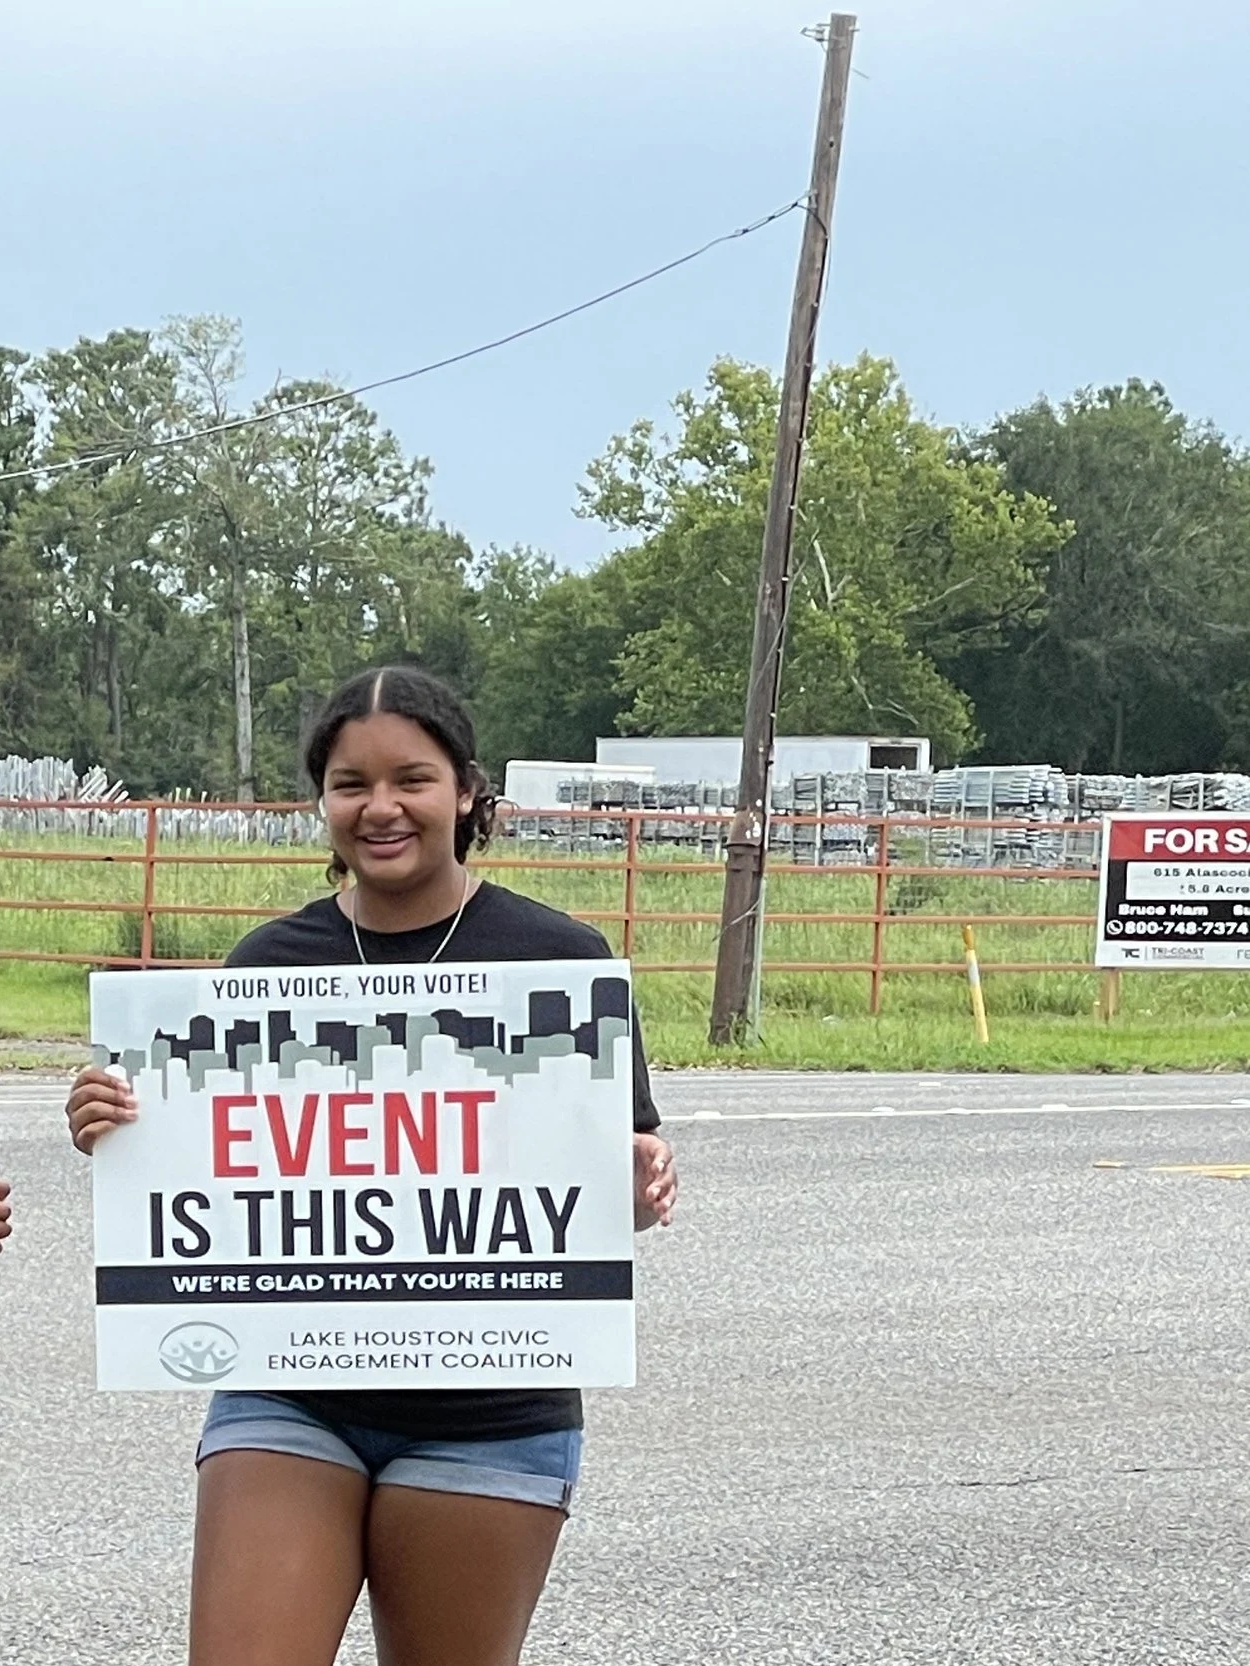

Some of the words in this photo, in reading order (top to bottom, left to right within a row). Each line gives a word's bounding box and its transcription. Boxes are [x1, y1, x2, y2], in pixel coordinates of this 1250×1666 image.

[1144, 828, 1219, 854] FOR
[1118, 903, 1166, 916] Bruce
[1170, 904, 1209, 916] Ham
[1124, 921, 1249, 935] 800-748-7374
[212, 978, 269, 999] YOUR
[277, 976, 349, 998] VOICE,
[358, 975, 416, 996] YOUR
[423, 973, 487, 994] VOTE!
[212, 1089, 497, 1179] EVENT
[149, 1190, 211, 1259] IS
[233, 1188, 395, 1257] THIS
[417, 1186, 582, 1255] WAY
[172, 1275, 251, 1293] WE'RE
[255, 1274, 325, 1292] GLAD
[328, 1273, 398, 1291] THAT
[401, 1272, 495, 1290] YOU'RE
[500, 1272, 563, 1289] HERE
[290, 1331, 345, 1347] LAKE
[354, 1330, 473, 1346] HOUSTON
[481, 1330, 549, 1346] CIVIC
[268, 1353, 433, 1370] ENGAGEMENT
[441, 1353, 572, 1369] COALITION
